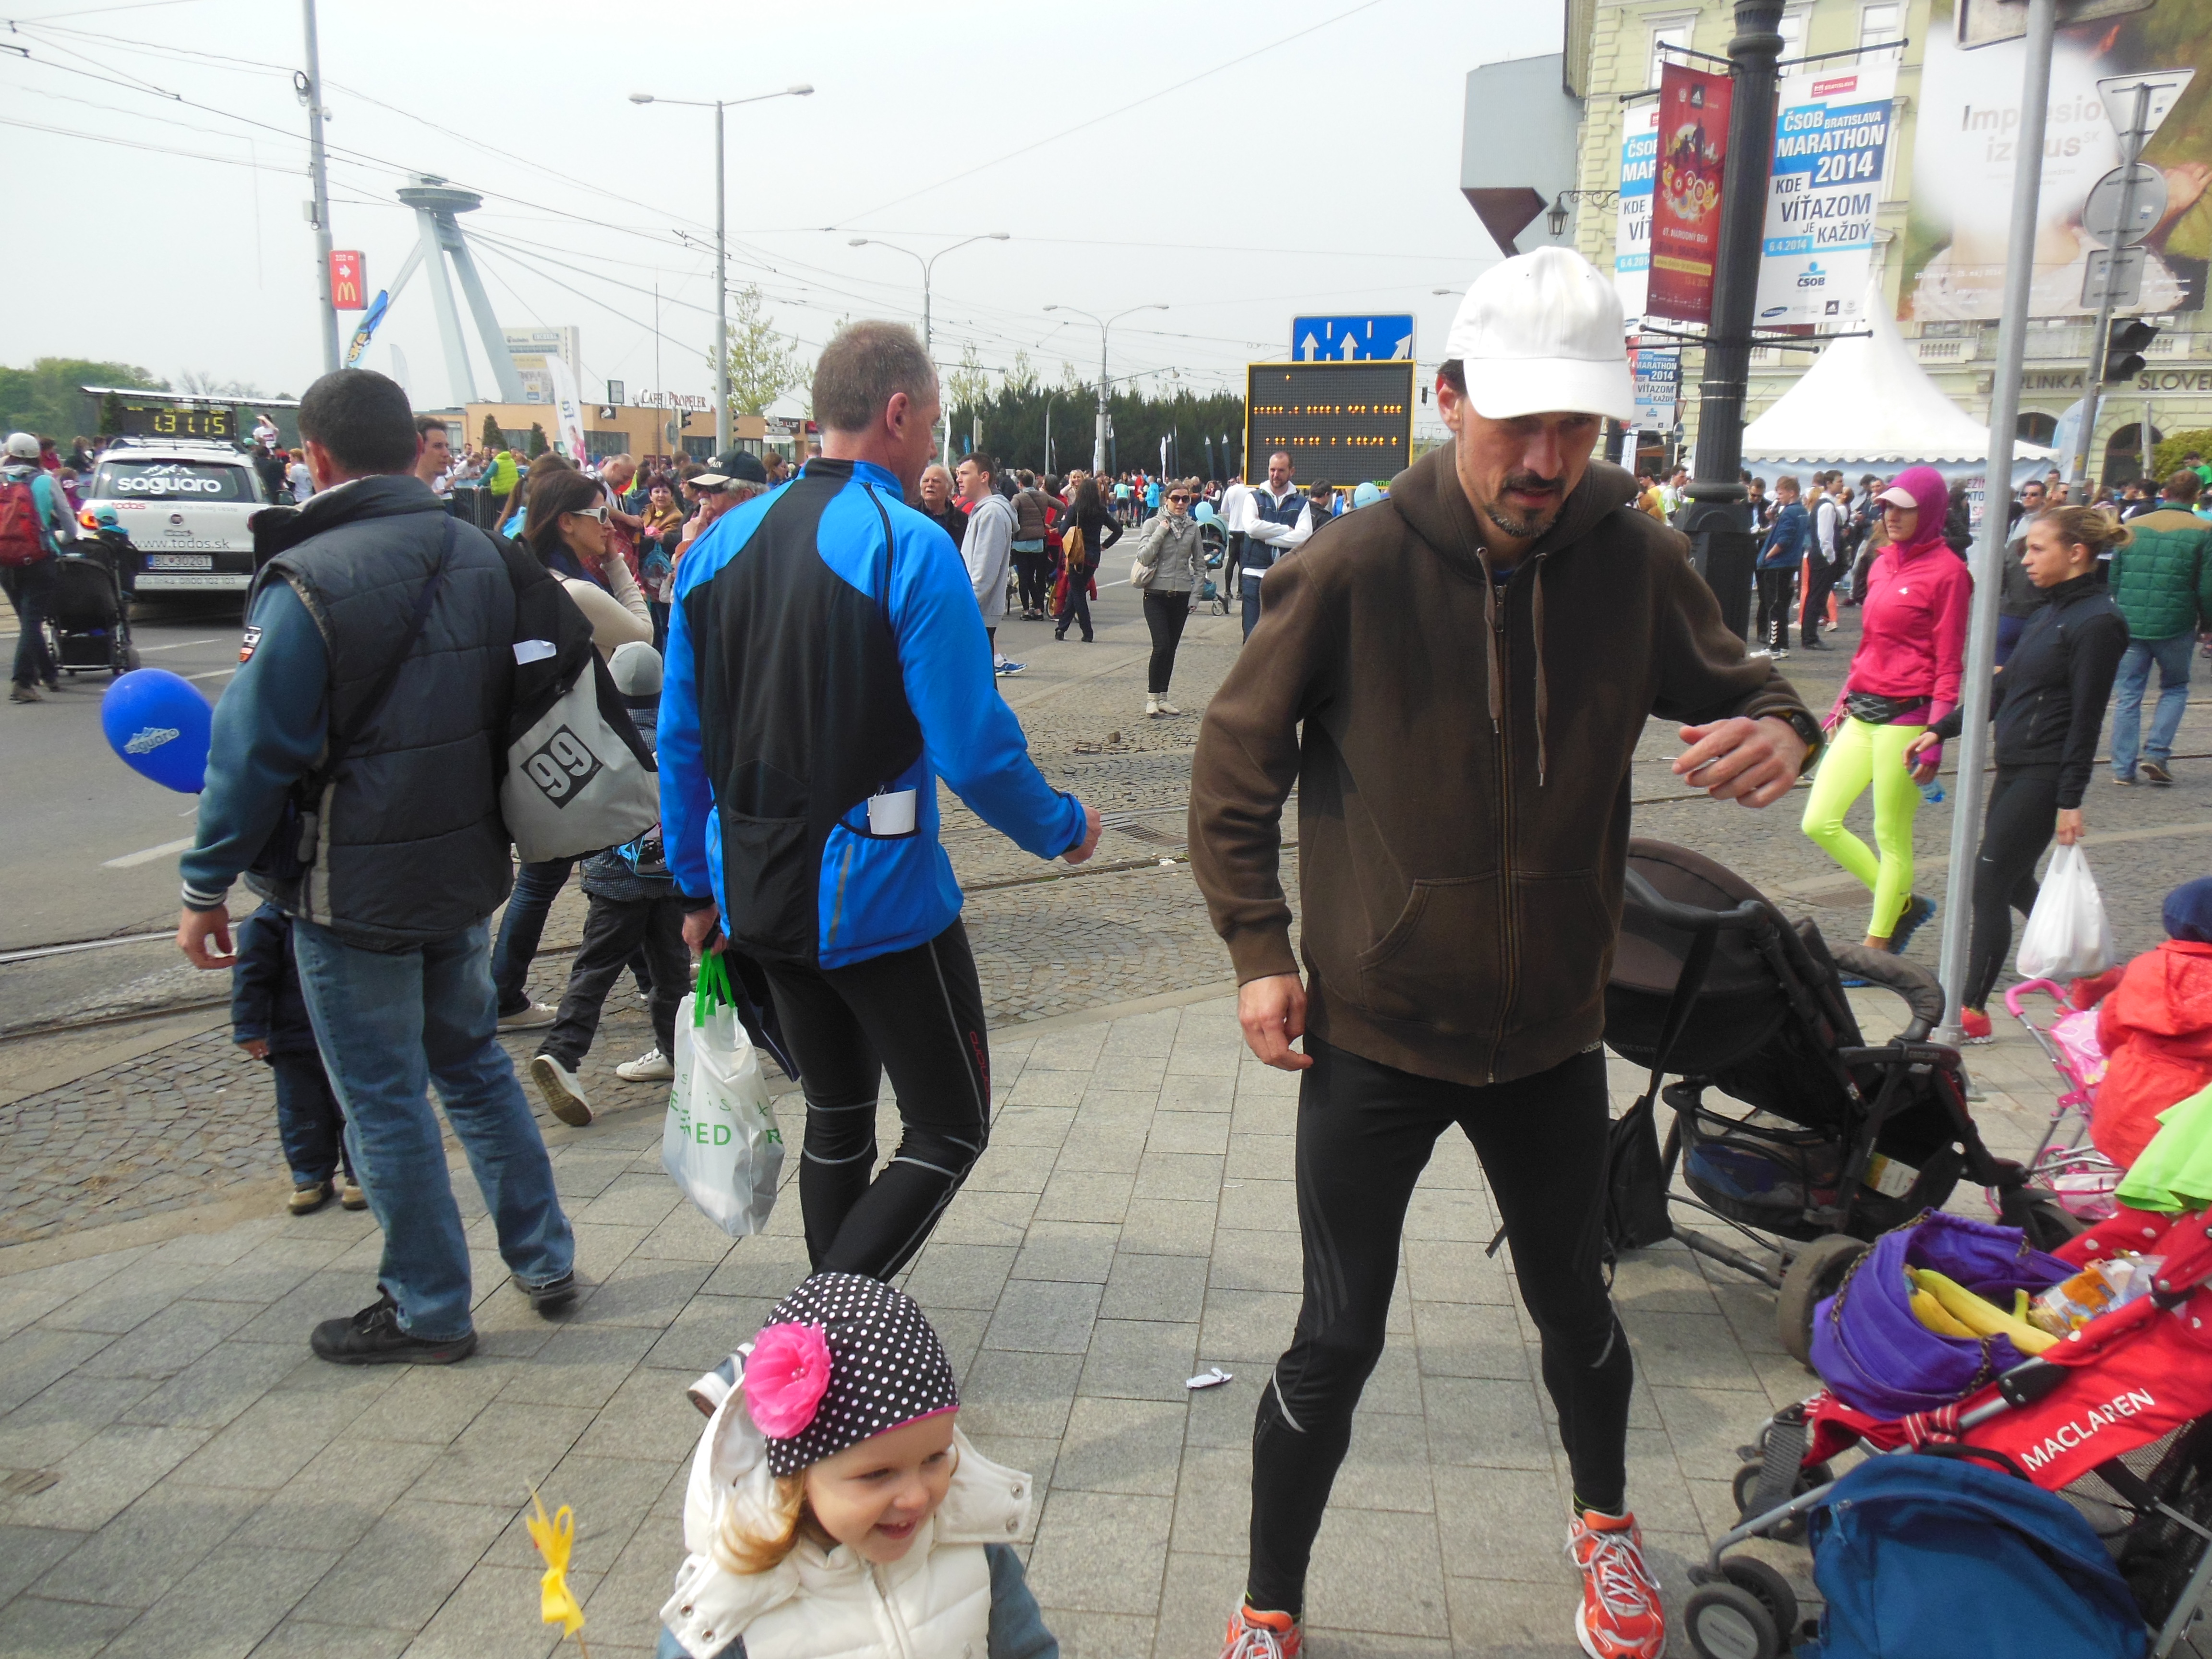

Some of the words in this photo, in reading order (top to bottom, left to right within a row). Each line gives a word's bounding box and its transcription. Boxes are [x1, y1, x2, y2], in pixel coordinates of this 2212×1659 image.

[1784, 110, 1823, 132] ČSOB
[1825, 111, 1881, 129] BRATISLAVA
[1777, 124, 1885, 157] MARATHON
[1815, 151, 1873, 182] 2014
[1776, 177, 1802, 194] KDE
[1623, 200, 1645, 215] KDE
[1781, 192, 1872, 222] VÍŤAZOM
[1803, 222, 1815, 233] JE
[1816, 218, 1871, 243] KAŽDÝ
[1651, 371, 1673, 380] 2014
[2139, 373, 2212, 390] SLOVE
[118, 478, 222, 494] saguaro
[125, 729, 178, 753] saguaro
[2020, 1387, 2155, 1471] MACLAREN
